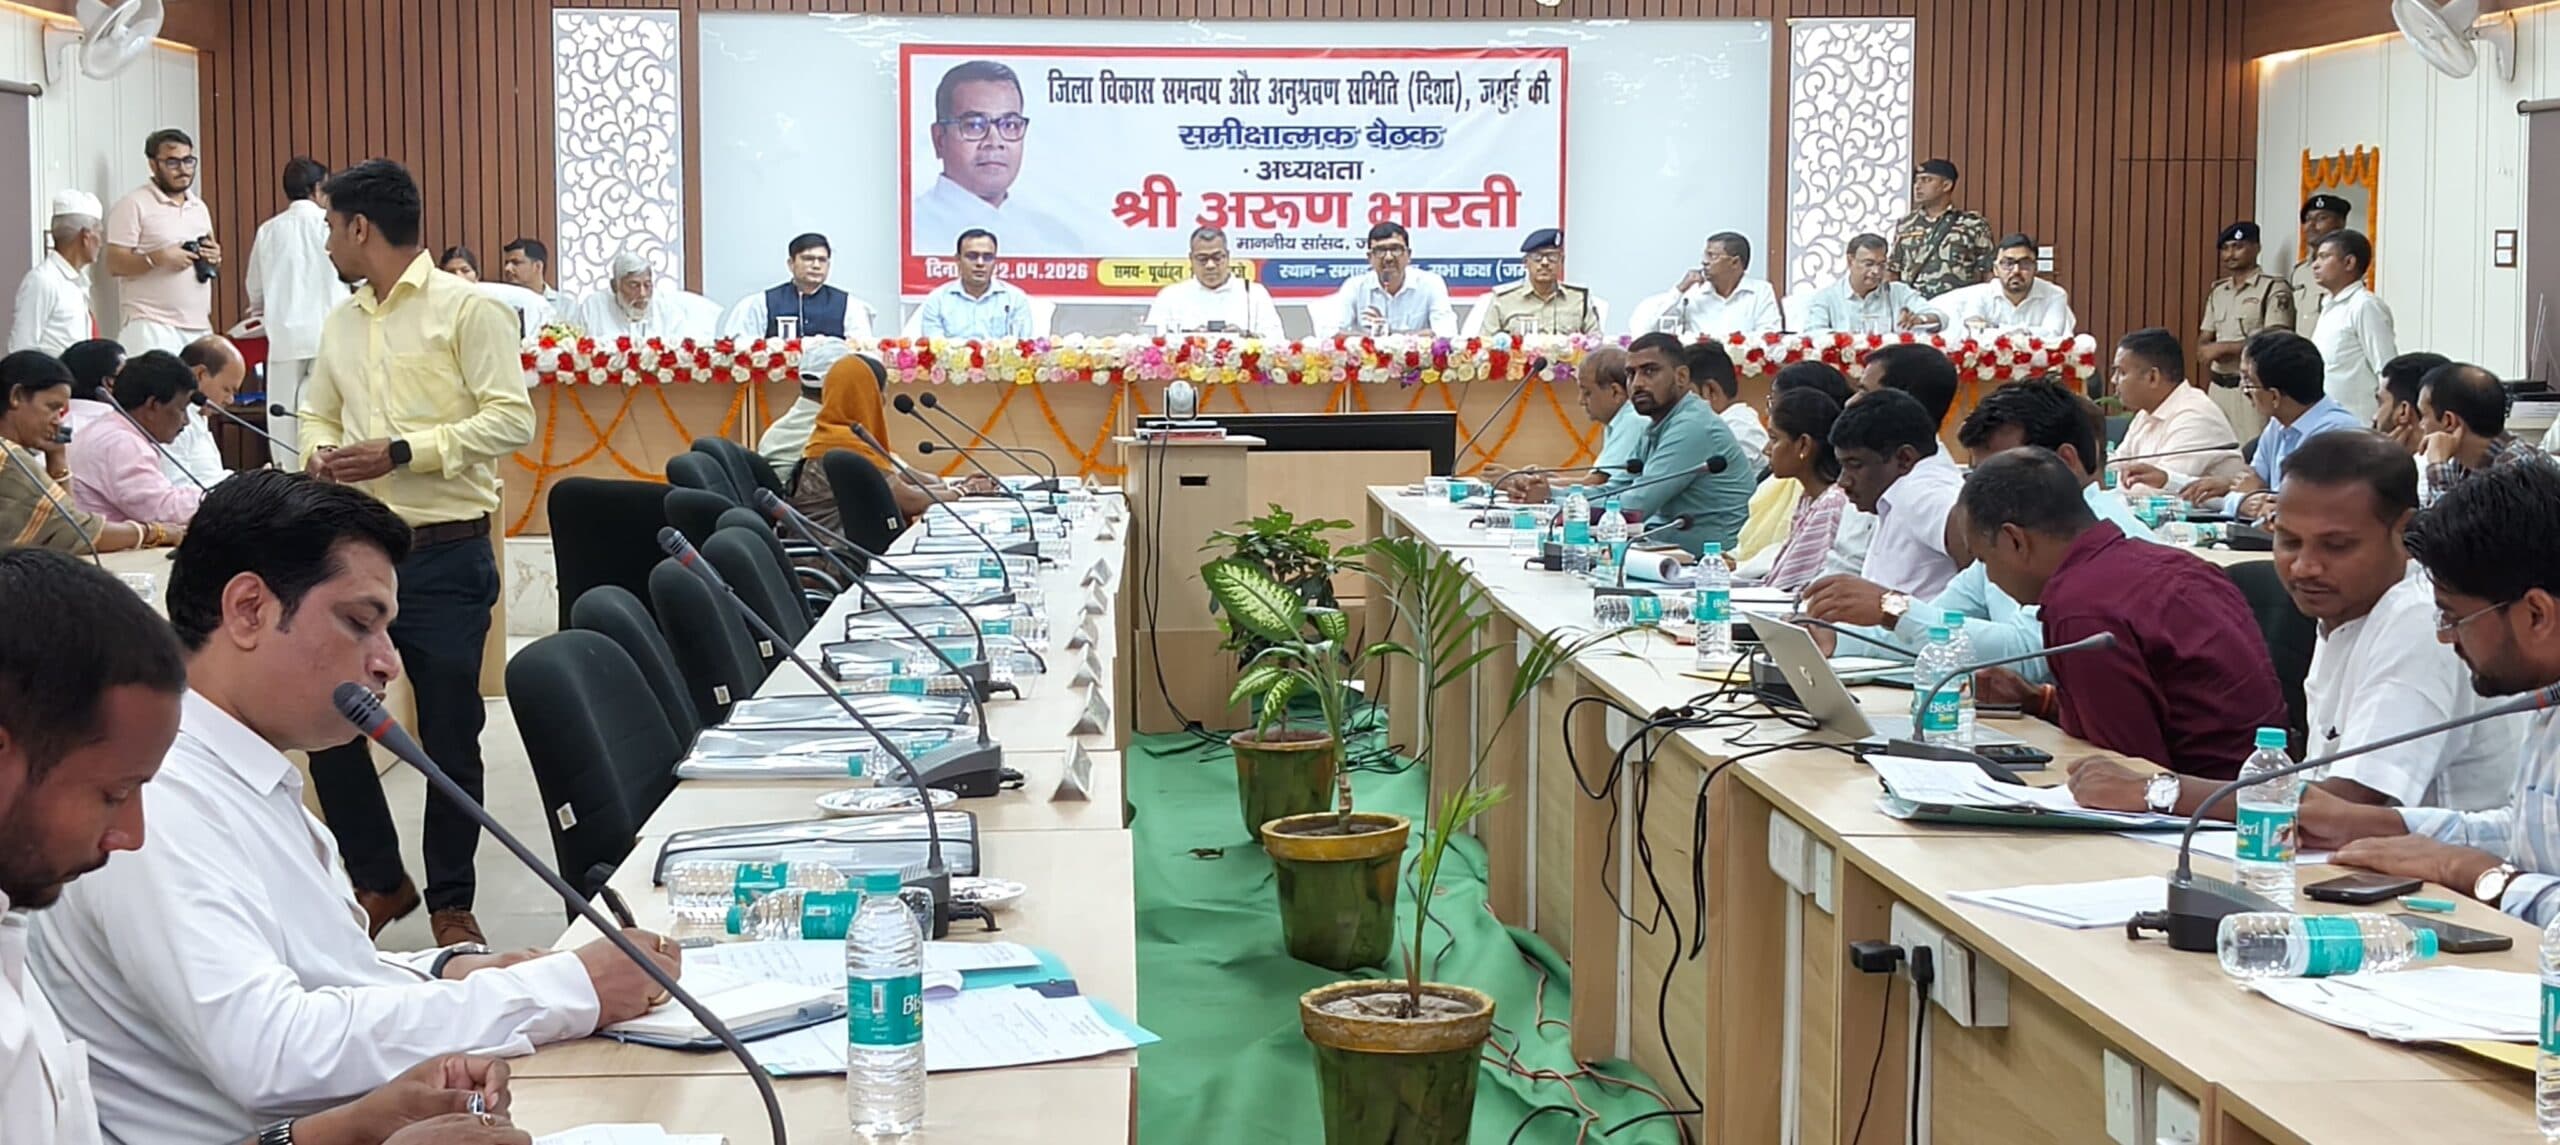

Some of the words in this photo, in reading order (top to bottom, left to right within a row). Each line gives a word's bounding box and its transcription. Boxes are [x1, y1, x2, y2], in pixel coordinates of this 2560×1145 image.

[1048, 68, 1094, 104] जिला
[1100, 69, 1155, 105] विकास
[1161, 77, 1222, 105] समन्वय
[1229, 70, 1261, 105] और
[1268, 77, 1340, 115] अनुश्रवण
[1347, 70, 1399, 105] समिति
[1479, 69, 1521, 113] जमुई
[1526, 69, 1551, 105] की
[1178, 117, 1357, 148] समीक्षात्मक
[1365, 117, 1445, 148] बैठक
[1256, 161, 1363, 180] अध्यक्षता
[1111, 174, 1182, 228] श्री
[1196, 192, 1352, 229] अरूण
[1368, 174, 1522, 229] भारती
[1236, 233, 1296, 250] माननीय
[925, 258, 959, 278] दिना
[993, 262, 1088, 279] 2.04.2026
